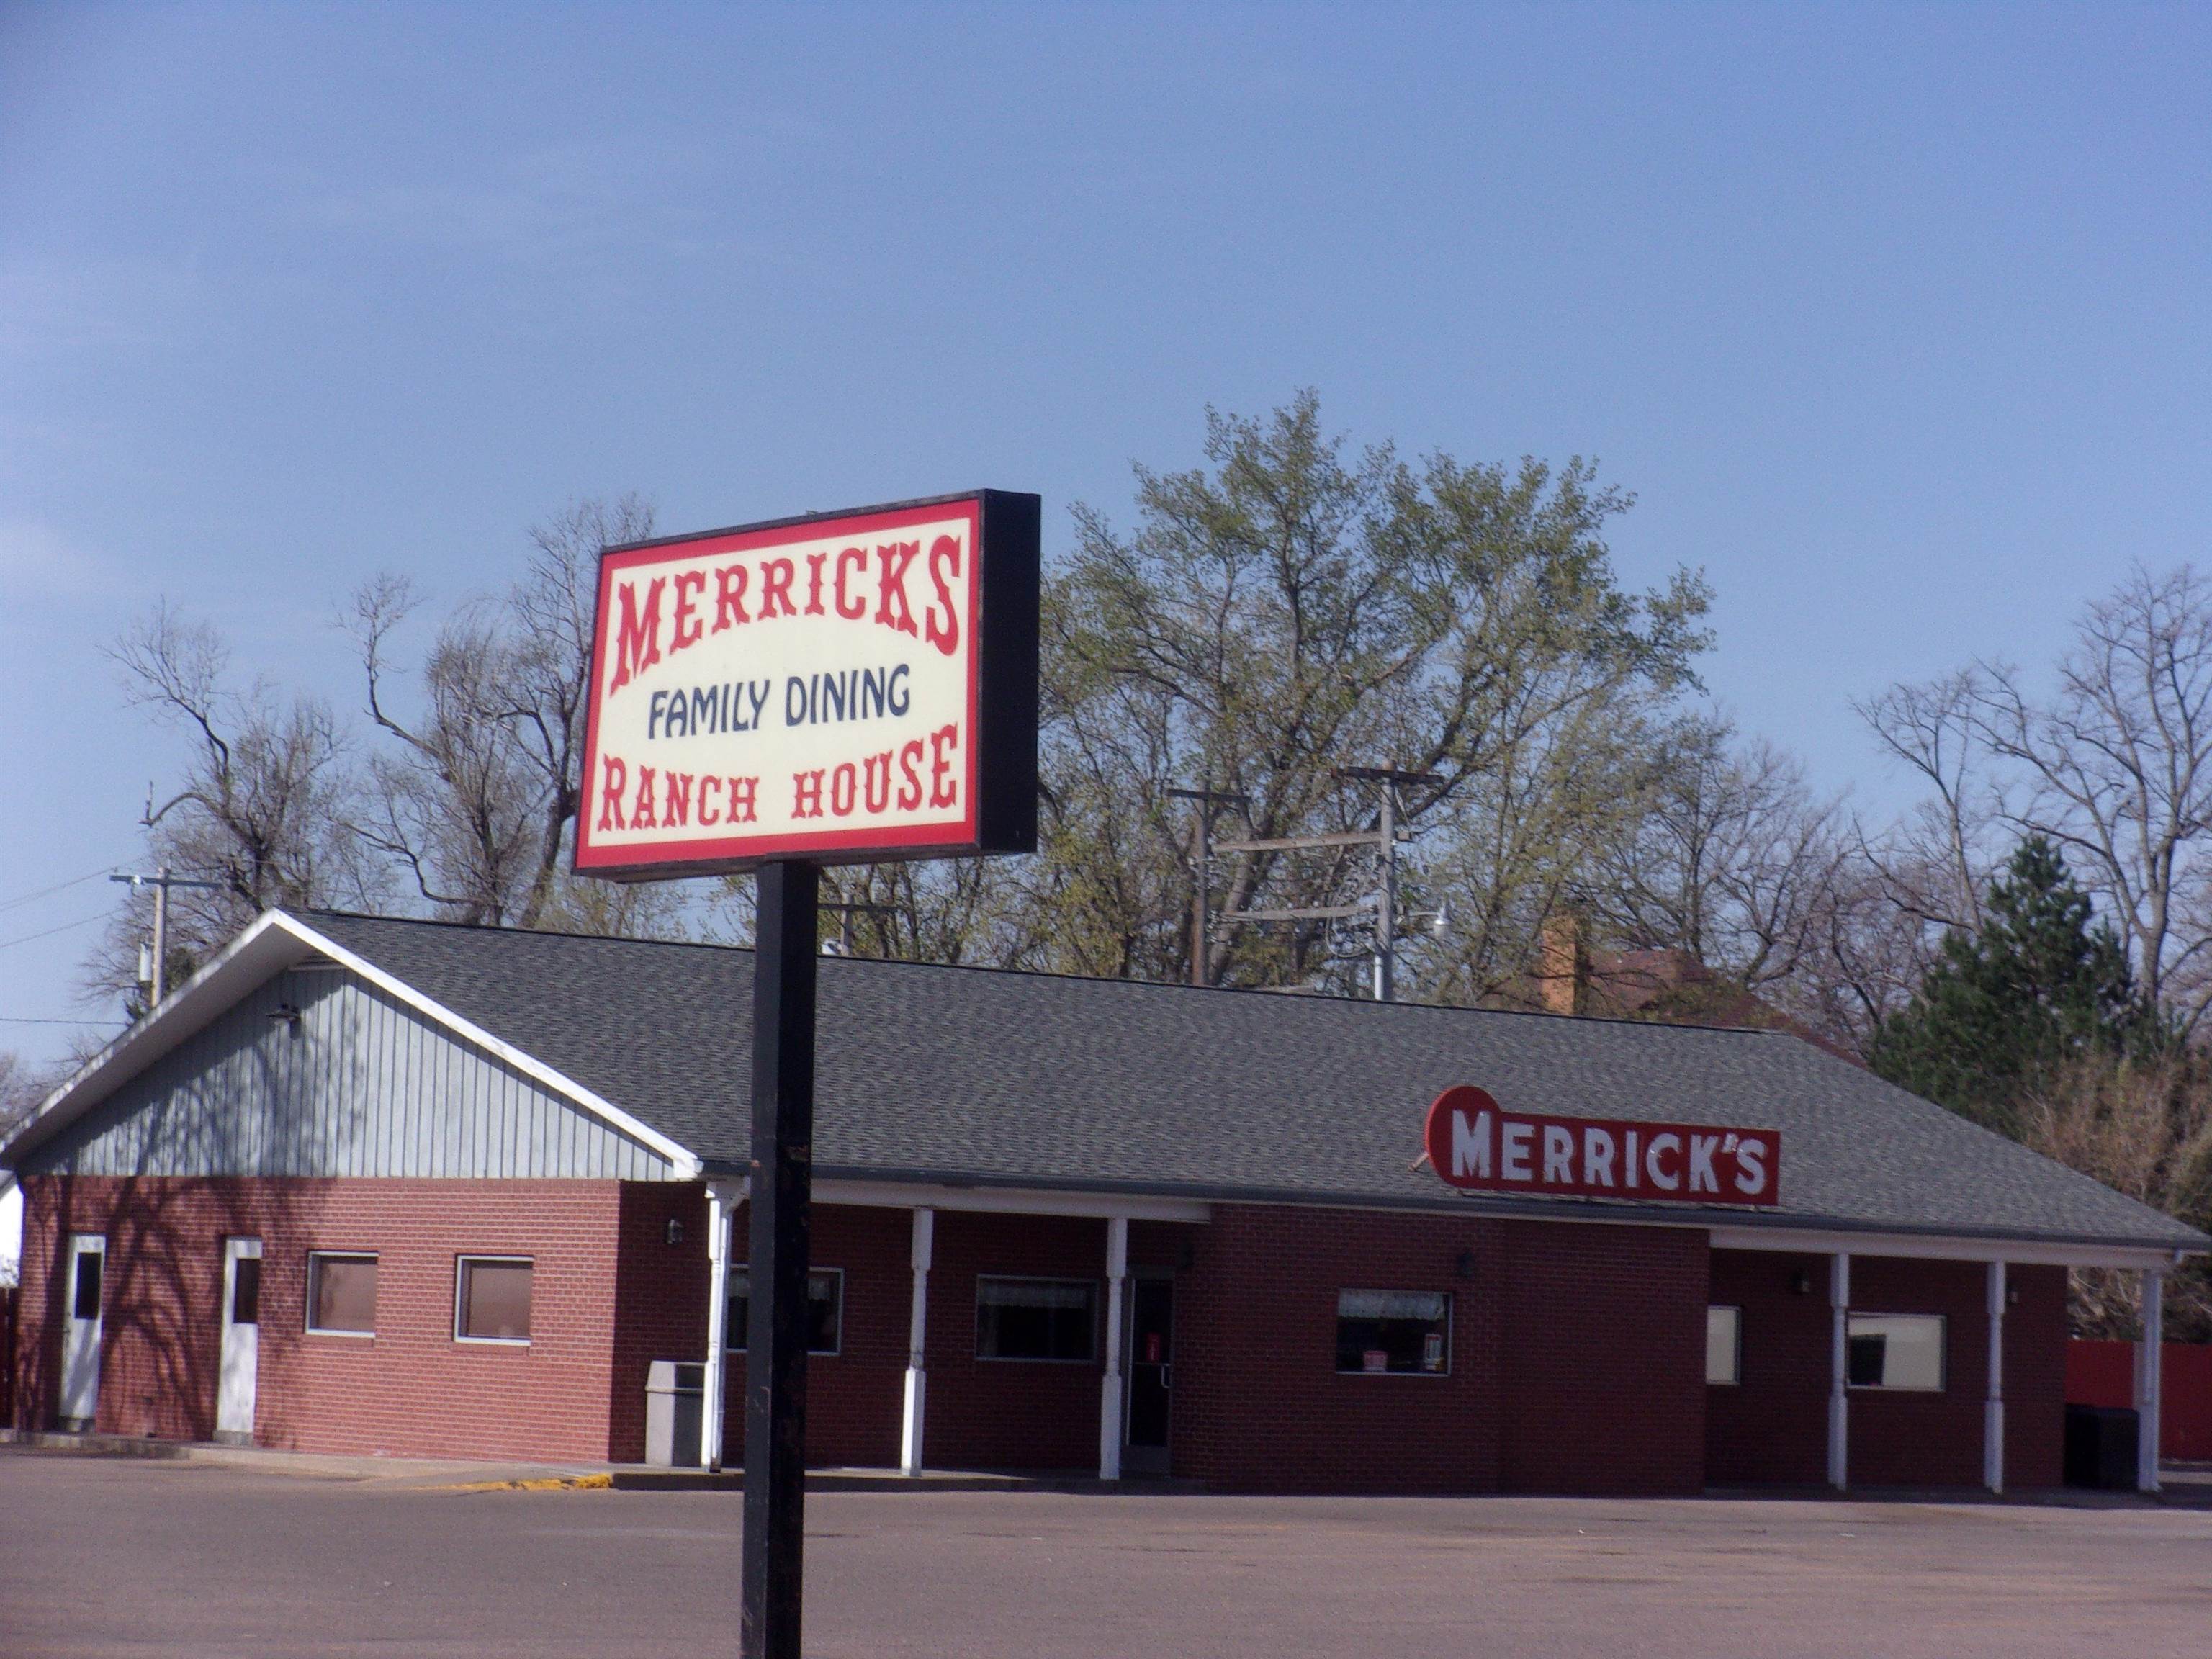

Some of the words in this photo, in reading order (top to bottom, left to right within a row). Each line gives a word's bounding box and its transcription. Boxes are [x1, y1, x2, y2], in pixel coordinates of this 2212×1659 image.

[610, 535, 961, 697] MERRICKS
[649, 680, 770, 739] FAMILY
[786, 664, 910, 727] DINING
[598, 753, 758, 832] RANCH
[791, 722, 958, 819] HOUSE
[1452, 1110, 1766, 1195] MERRICK'S
